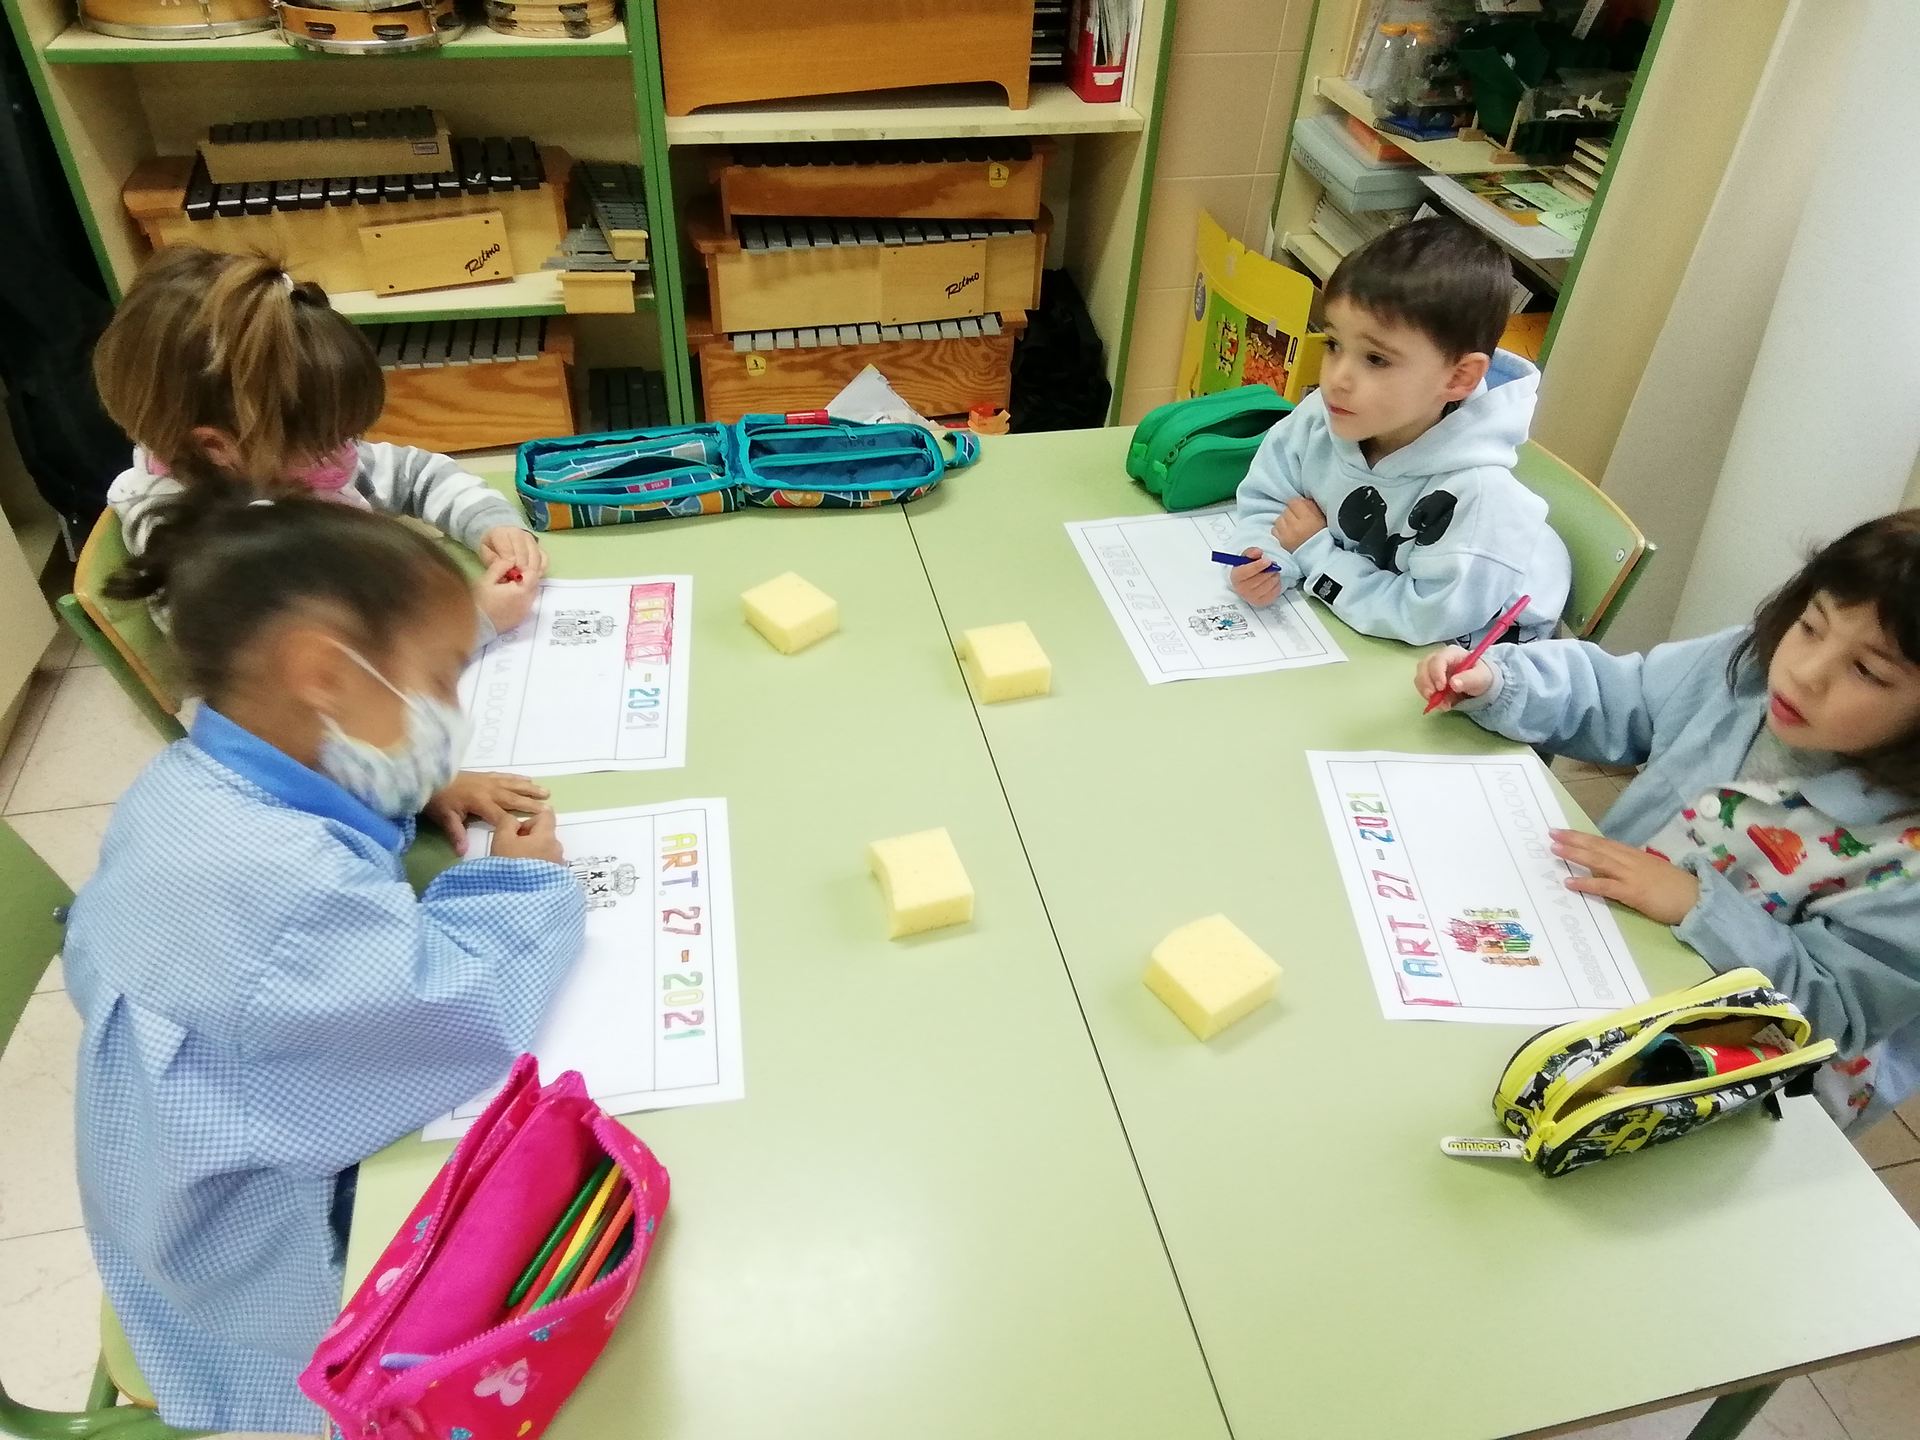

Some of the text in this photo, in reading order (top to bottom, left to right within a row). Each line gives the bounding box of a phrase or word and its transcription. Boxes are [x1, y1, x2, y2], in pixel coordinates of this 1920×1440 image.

[464, 243, 500, 277] Ritmo
[945, 272, 980, 299] Ritmo
[625, 687, 661, 730] 2021
[1345, 792, 1396, 843] 2021
[658, 832, 699, 897] ART.
[1371, 869, 1418, 901] 27
[661, 906, 701, 936] 27
[663, 971, 706, 1041] 2021
